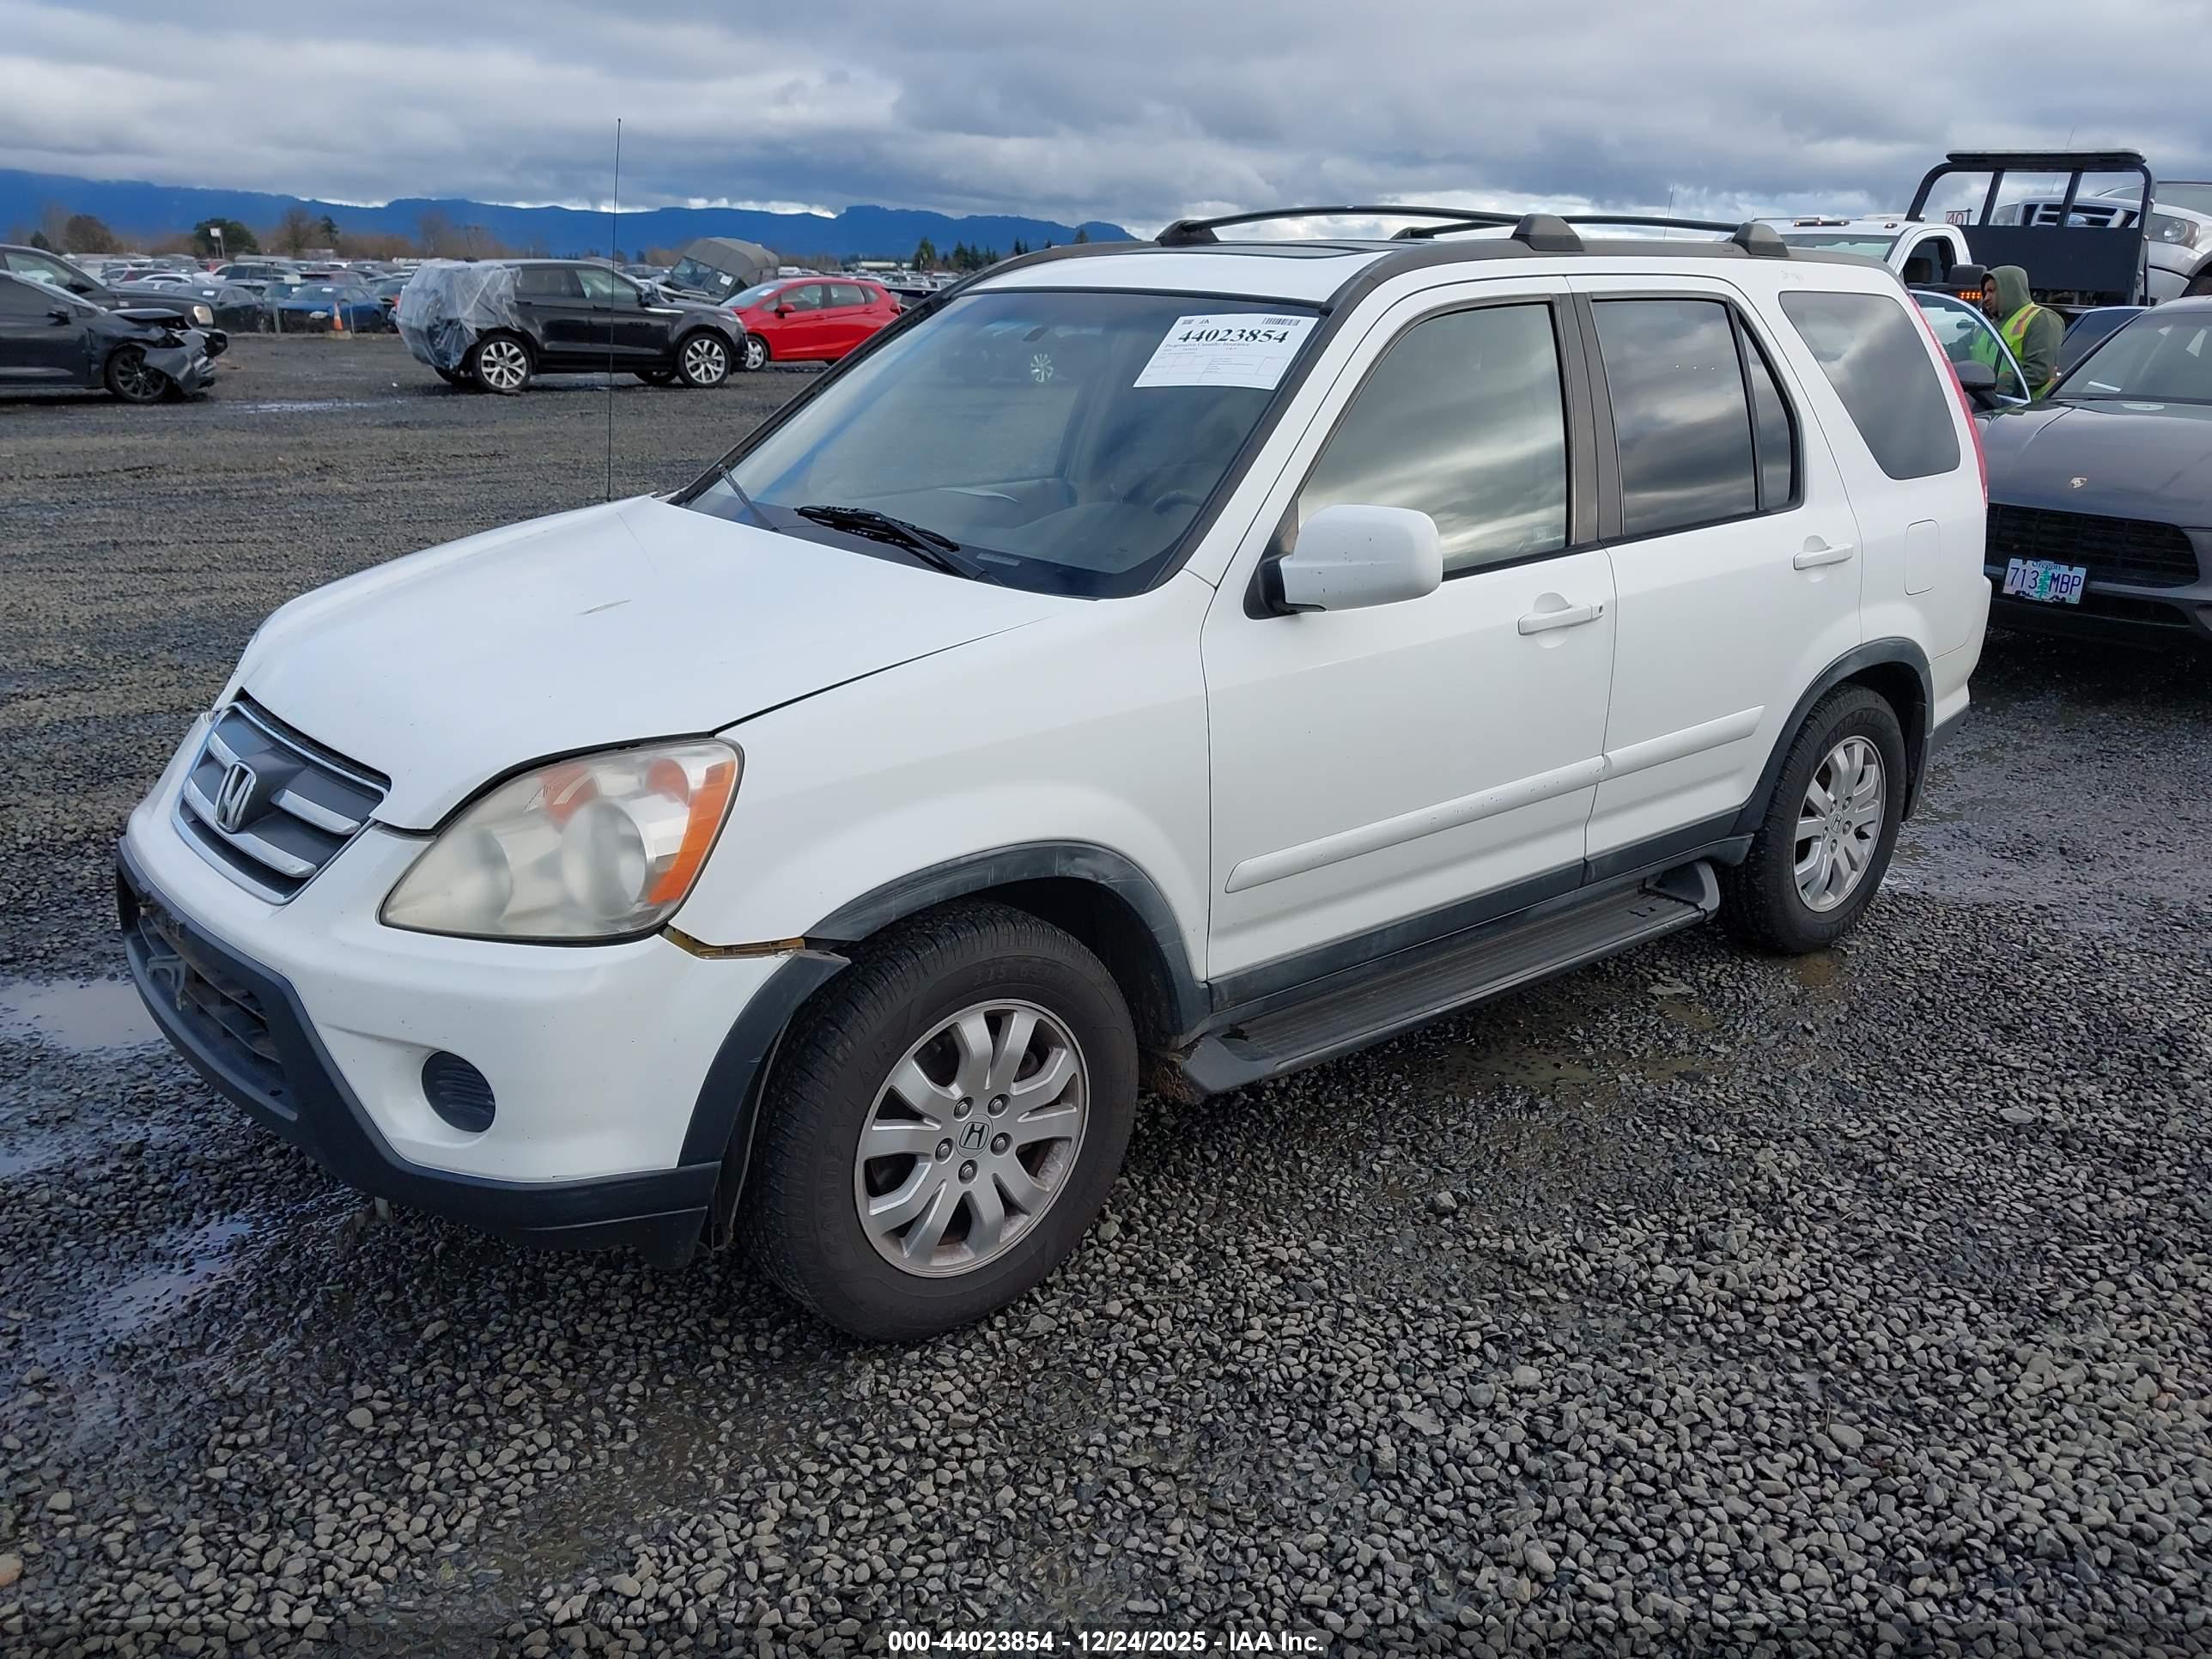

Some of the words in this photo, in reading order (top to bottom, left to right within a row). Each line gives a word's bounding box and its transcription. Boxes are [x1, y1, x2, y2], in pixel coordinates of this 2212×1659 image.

[1178, 329, 1289, 343] 44023854
[2032, 562, 2061, 571] Oregon
[2011, 568, 2039, 589] 713
[2049, 573, 2081, 595] MBP
